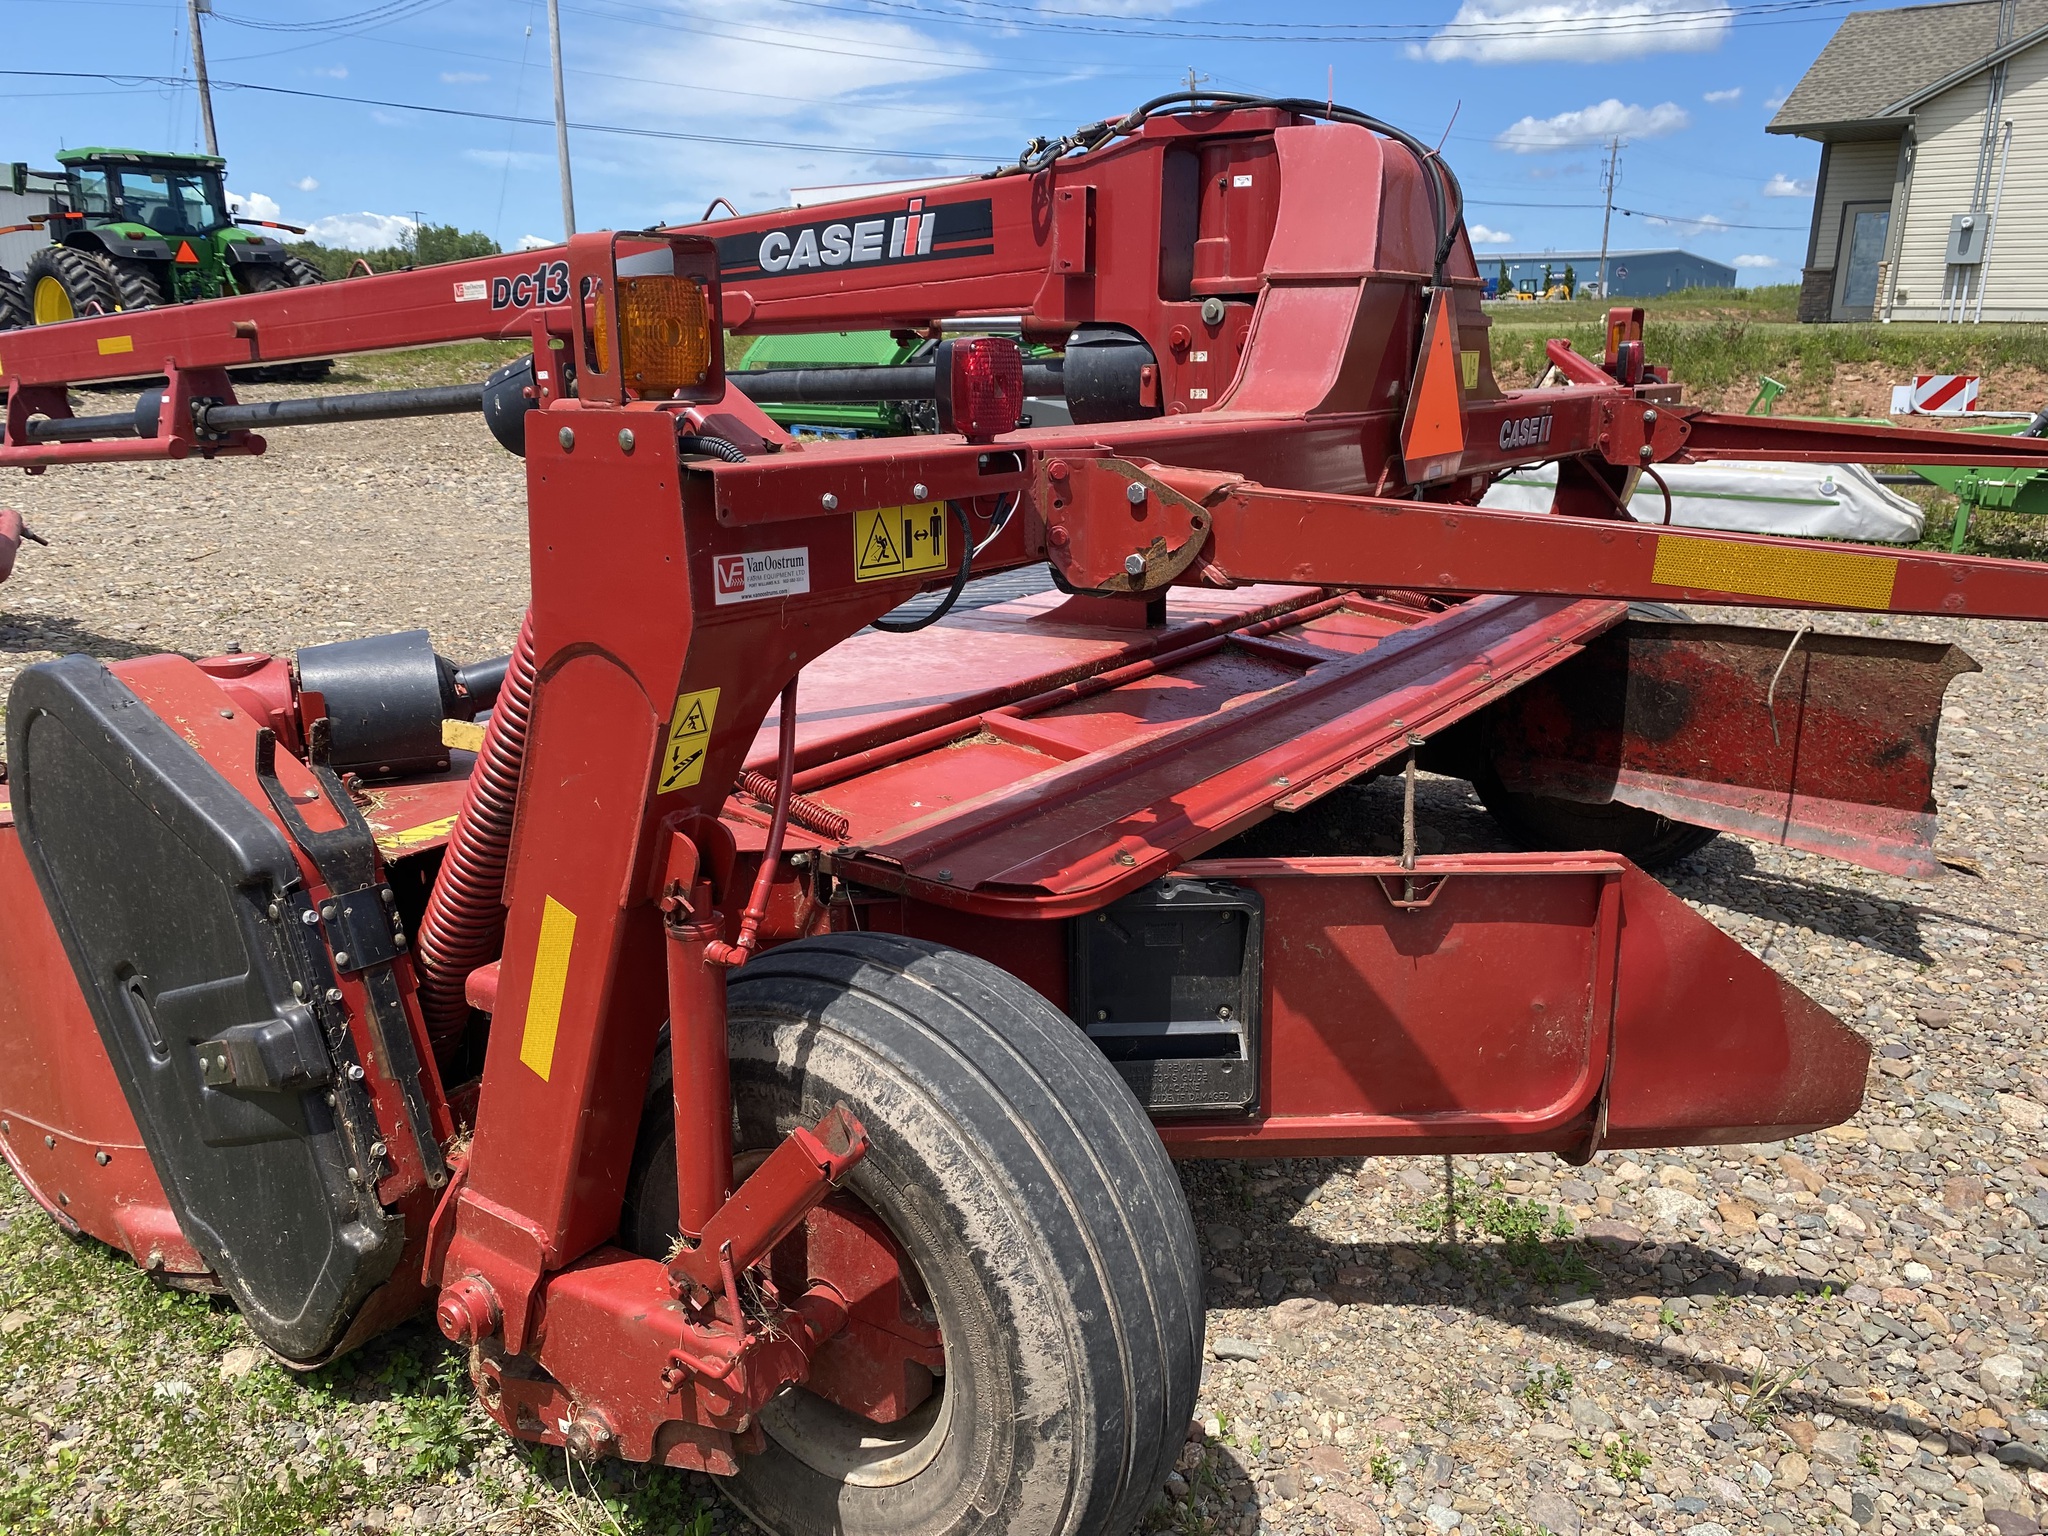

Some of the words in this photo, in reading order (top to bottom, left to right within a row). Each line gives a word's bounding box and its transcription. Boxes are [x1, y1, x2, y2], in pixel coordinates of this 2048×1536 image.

[758, 218, 886, 272] CASE
[1499, 417, 1541, 450] CASE
[764, 571, 794, 580] EQUIPMENT
[1167, 1062, 1203, 1073] REMOVE
[1181, 1072, 1208, 1083] GUIDE
[1160, 1082, 1201, 1093] MACHINE
[1176, 1093, 1186, 1103] IF
[1189, 1090, 1231, 1102] DAMAGED
